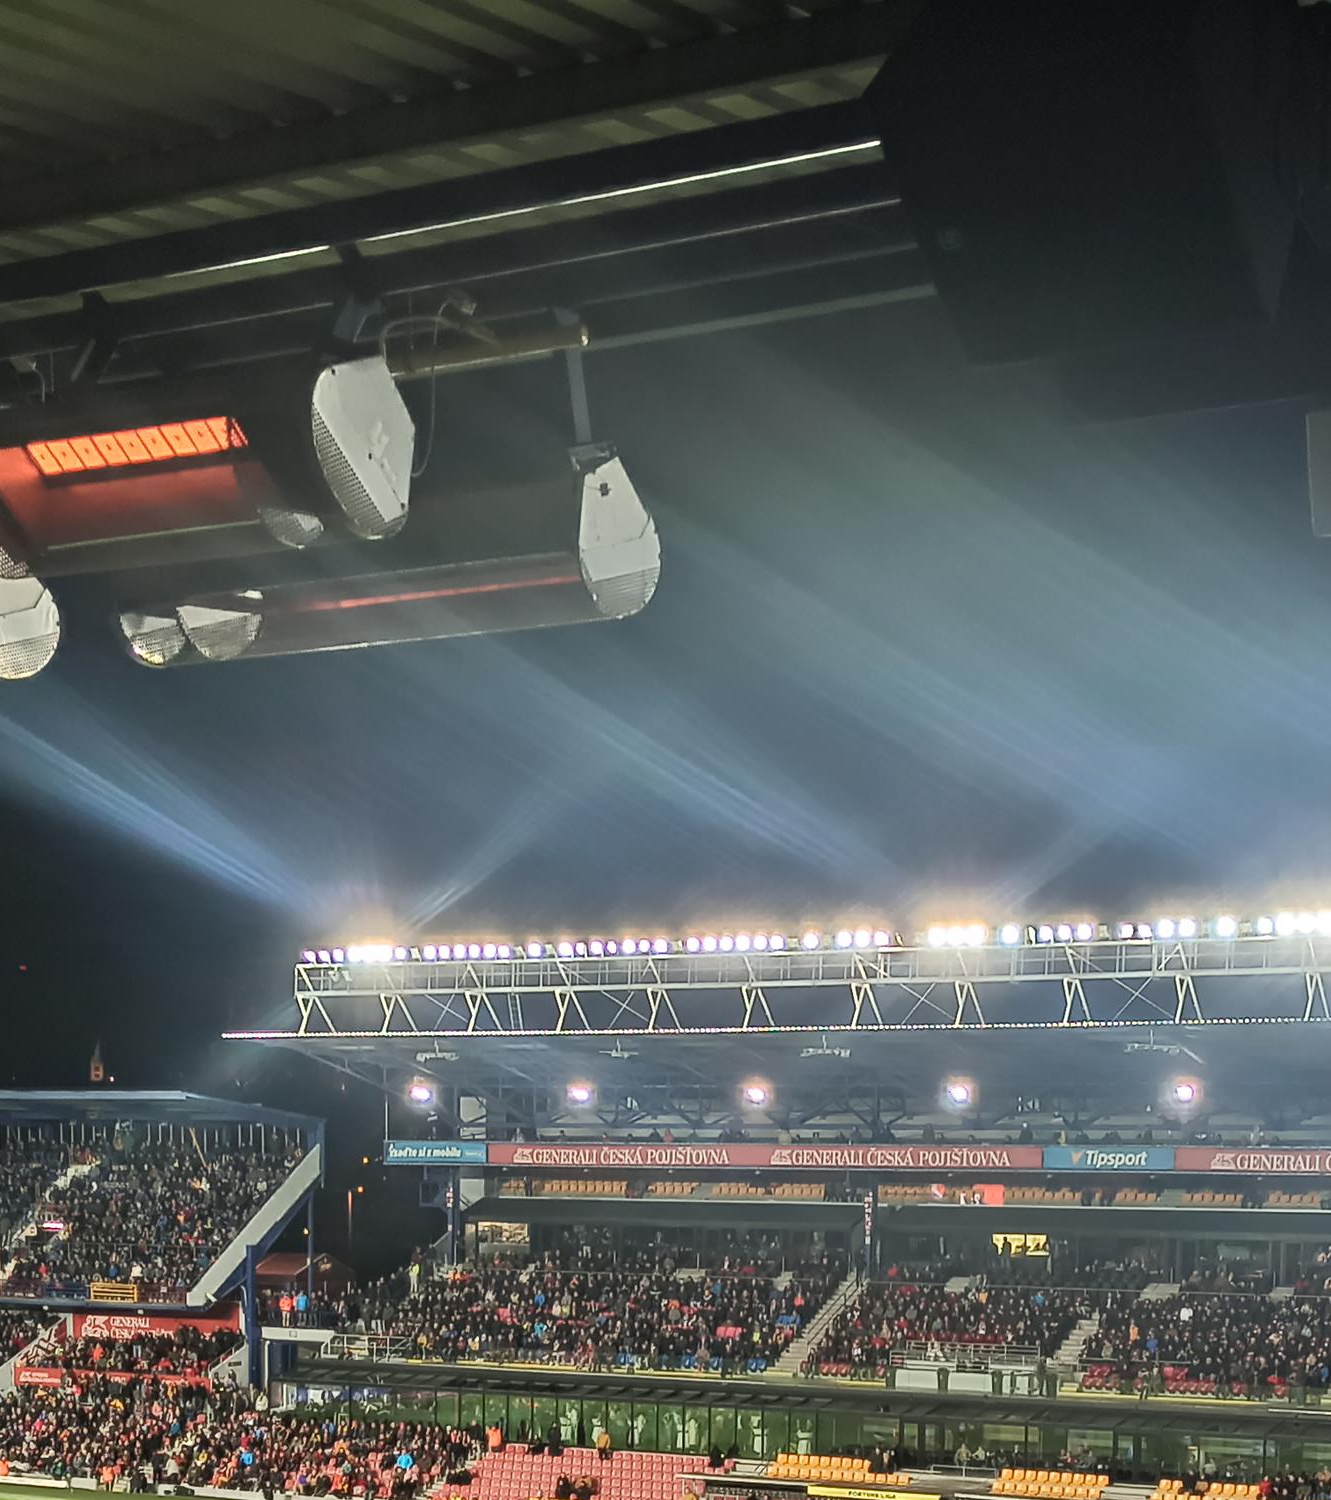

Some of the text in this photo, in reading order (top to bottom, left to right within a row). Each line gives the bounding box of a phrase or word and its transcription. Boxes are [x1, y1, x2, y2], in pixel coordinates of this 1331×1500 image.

[533, 1146, 729, 1165] GENERALI ČESKÁ POJIŠŤOVNA
[792, 1147, 1011, 1167] GENERALI ČESKÁ POJIŠŤOVNA
[1085, 1150, 1148, 1169] Tipsport
[1236, 1153, 1320, 1171] GENERALI
